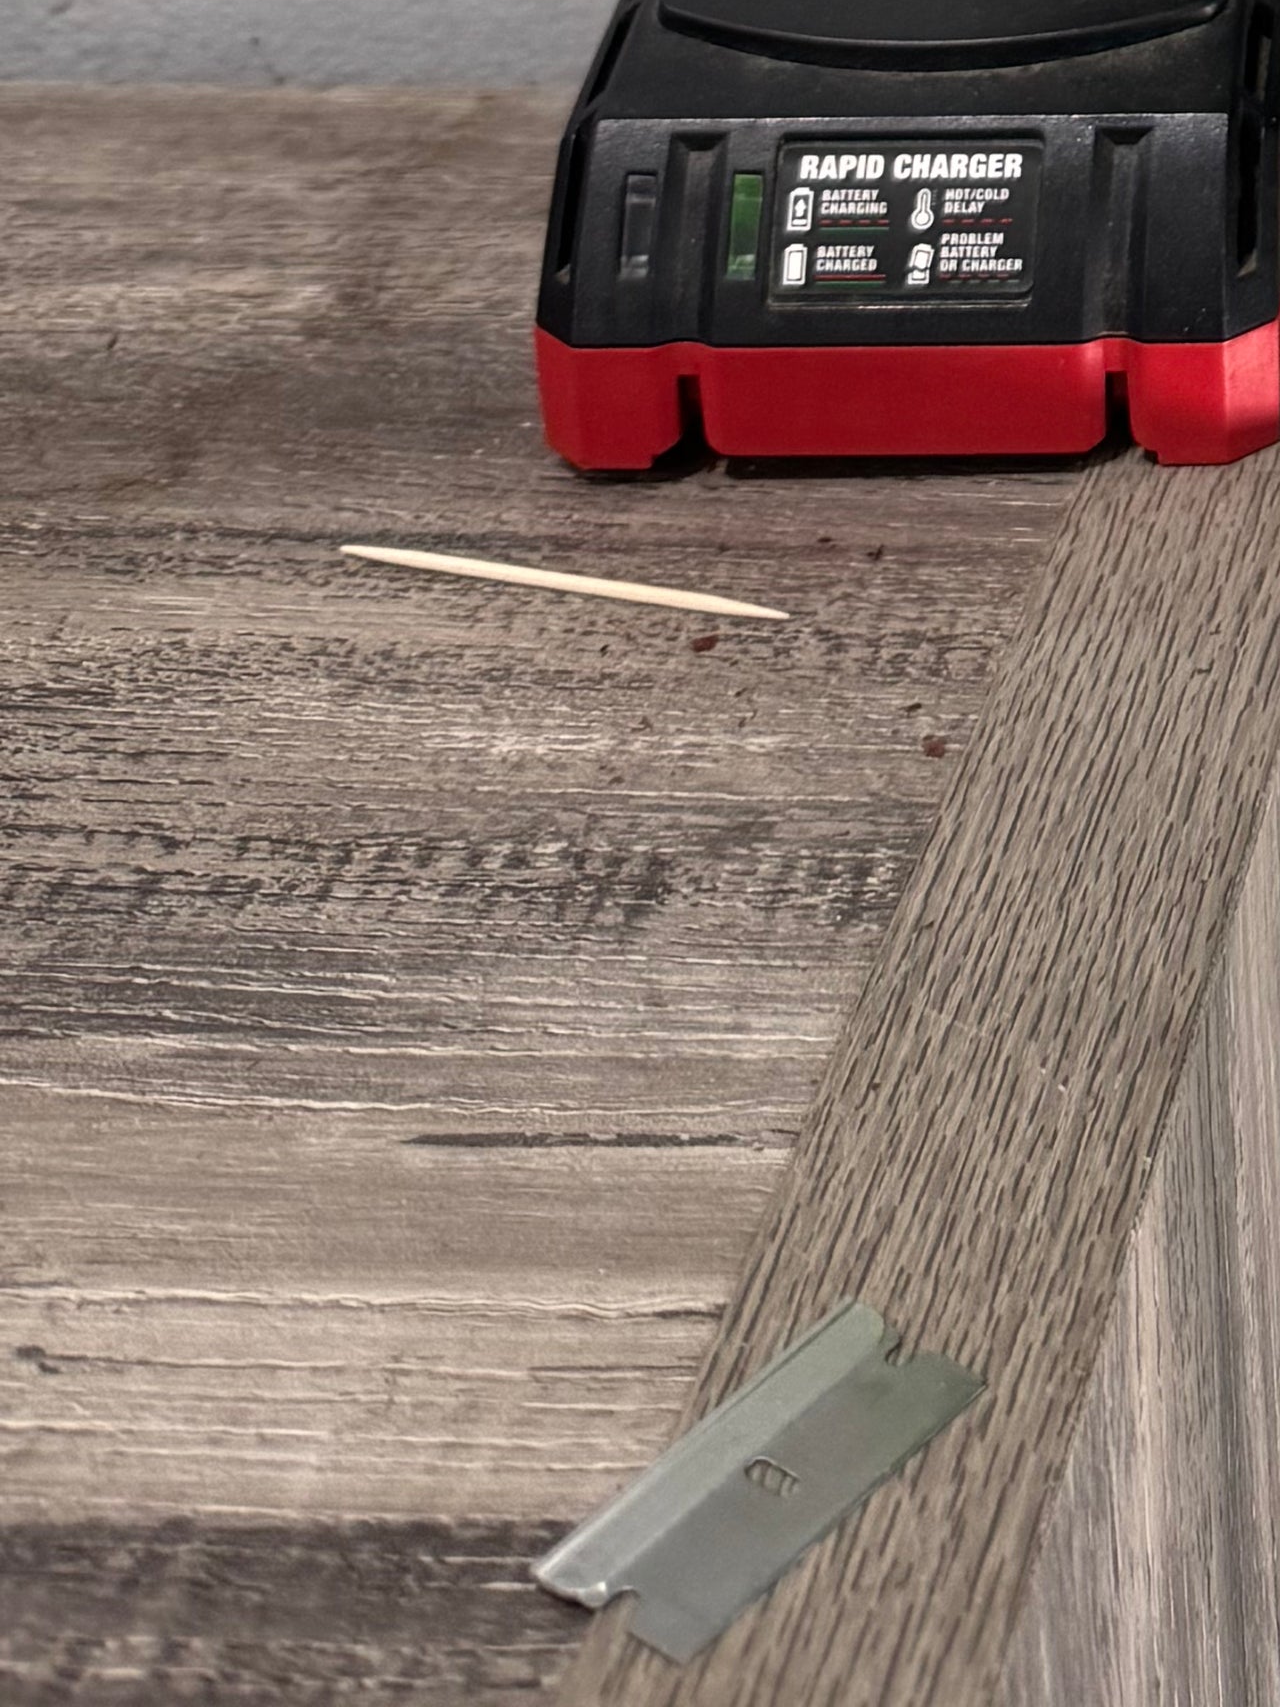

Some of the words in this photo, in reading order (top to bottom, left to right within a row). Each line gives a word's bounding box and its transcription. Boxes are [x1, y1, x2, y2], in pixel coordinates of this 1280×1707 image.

[800, 155, 885, 179] RAPID
[893, 153, 1023, 179] CHARGER
[822, 189, 879, 201] BATTERY
[944, 188, 1010, 200] HOT/COLD
[821, 202, 888, 214] CHARGING
[944, 201, 985, 213] DELAY
[940, 233, 1004, 245] PROBLEM
[816, 246, 874, 258] BATTERY
[939, 246, 997, 258] BATTERY
[815, 259, 878, 271] CHARGED
[939, 259, 958, 271] OR
[962, 259, 1023, 271] CHARGER
